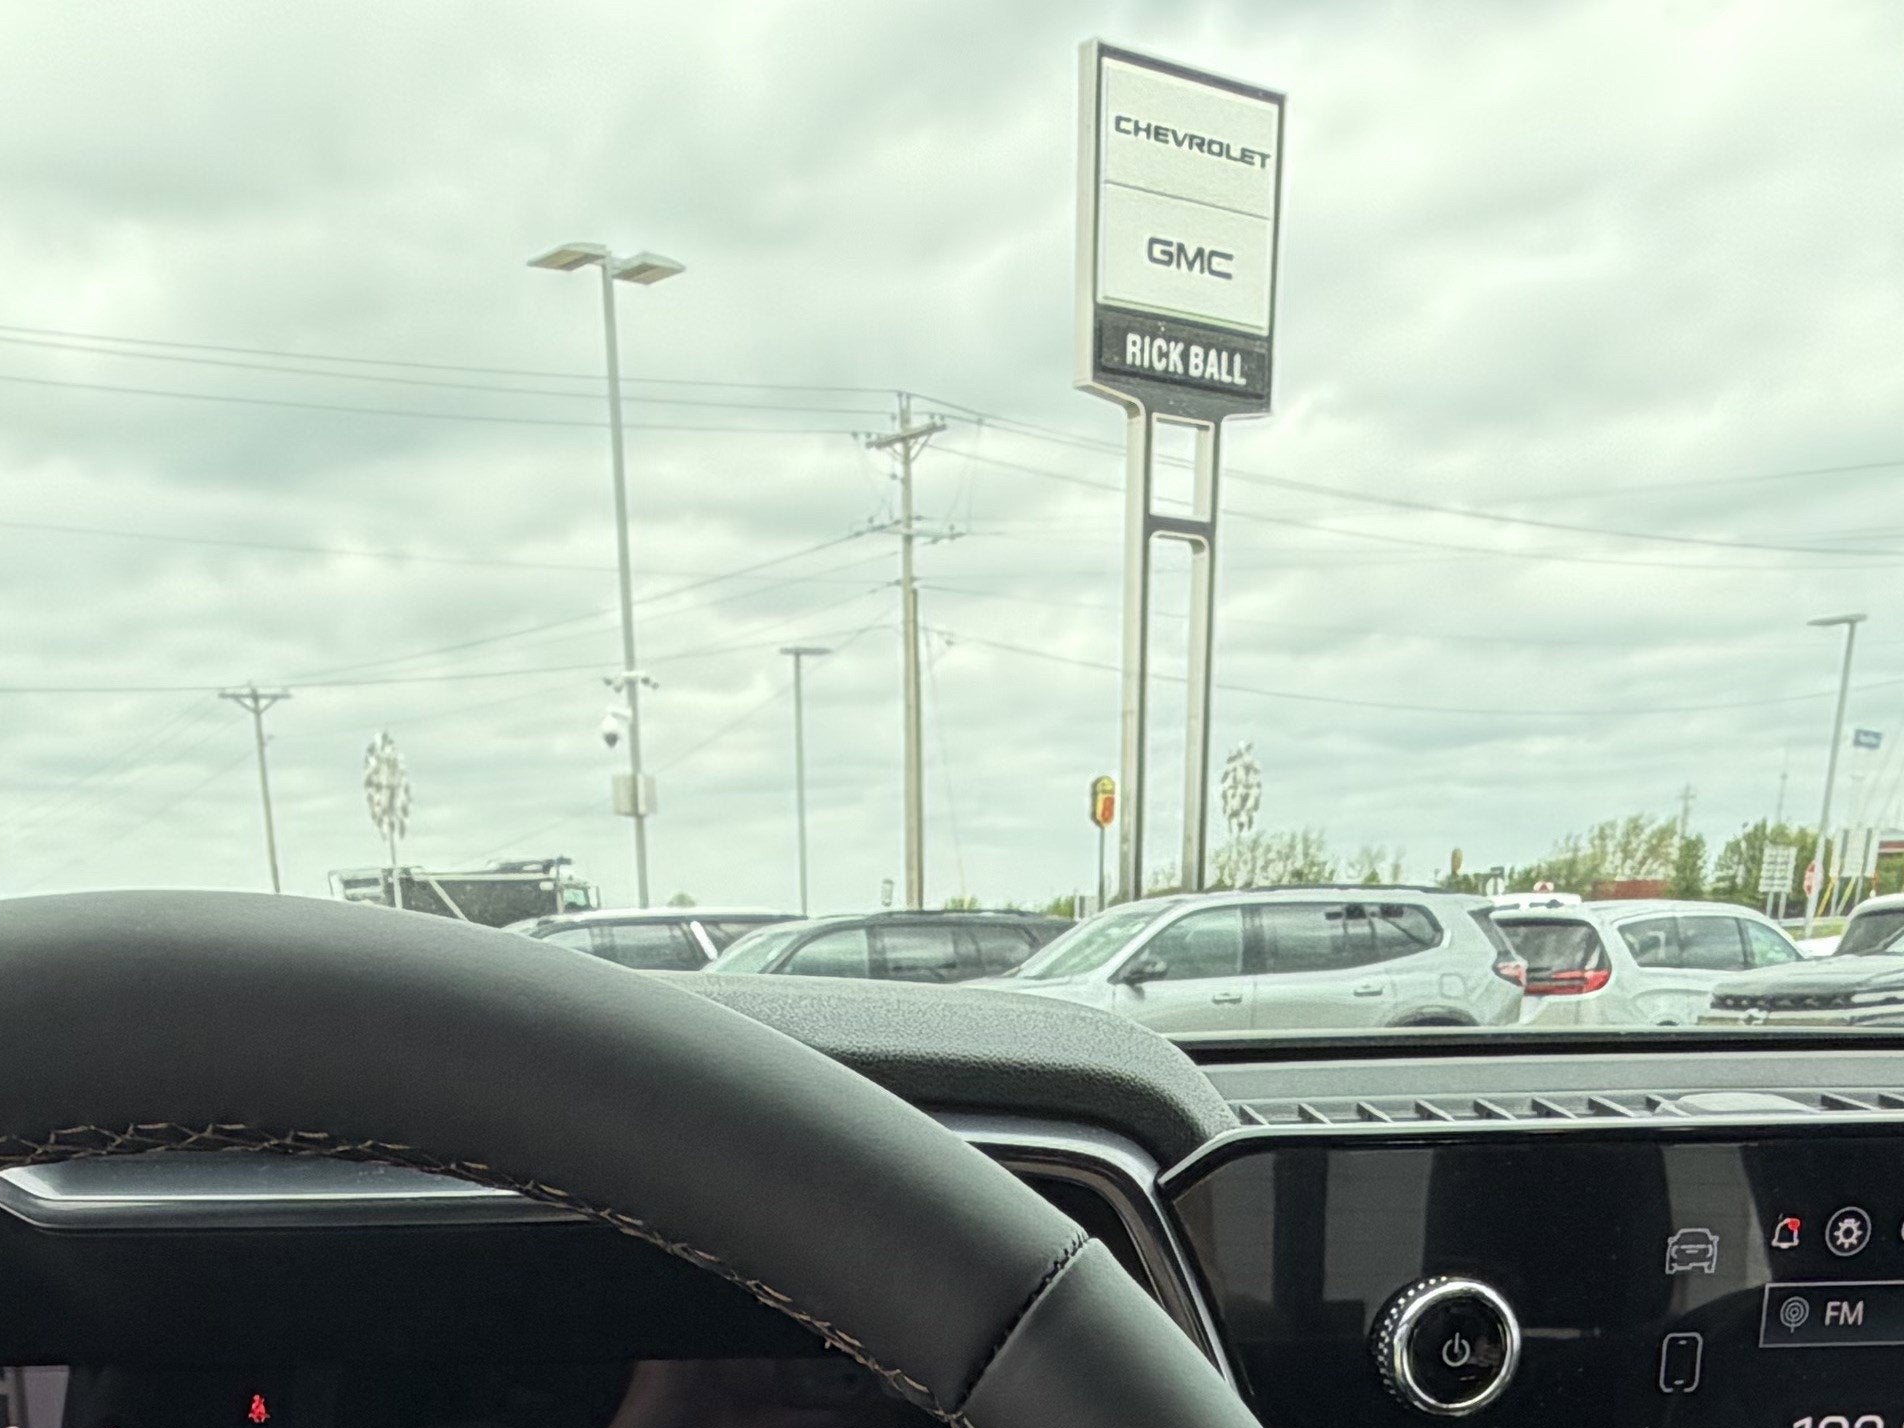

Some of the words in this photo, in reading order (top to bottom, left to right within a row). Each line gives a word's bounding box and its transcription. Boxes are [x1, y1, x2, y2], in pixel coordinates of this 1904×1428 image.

[1114, 115, 1271, 169] CHEVROLET
[1147, 236, 1234, 280] GMC
[1125, 333, 1185, 375] RICK
[1189, 344, 1247, 386] BALL
[1824, 1301, 1863, 1326] FM
